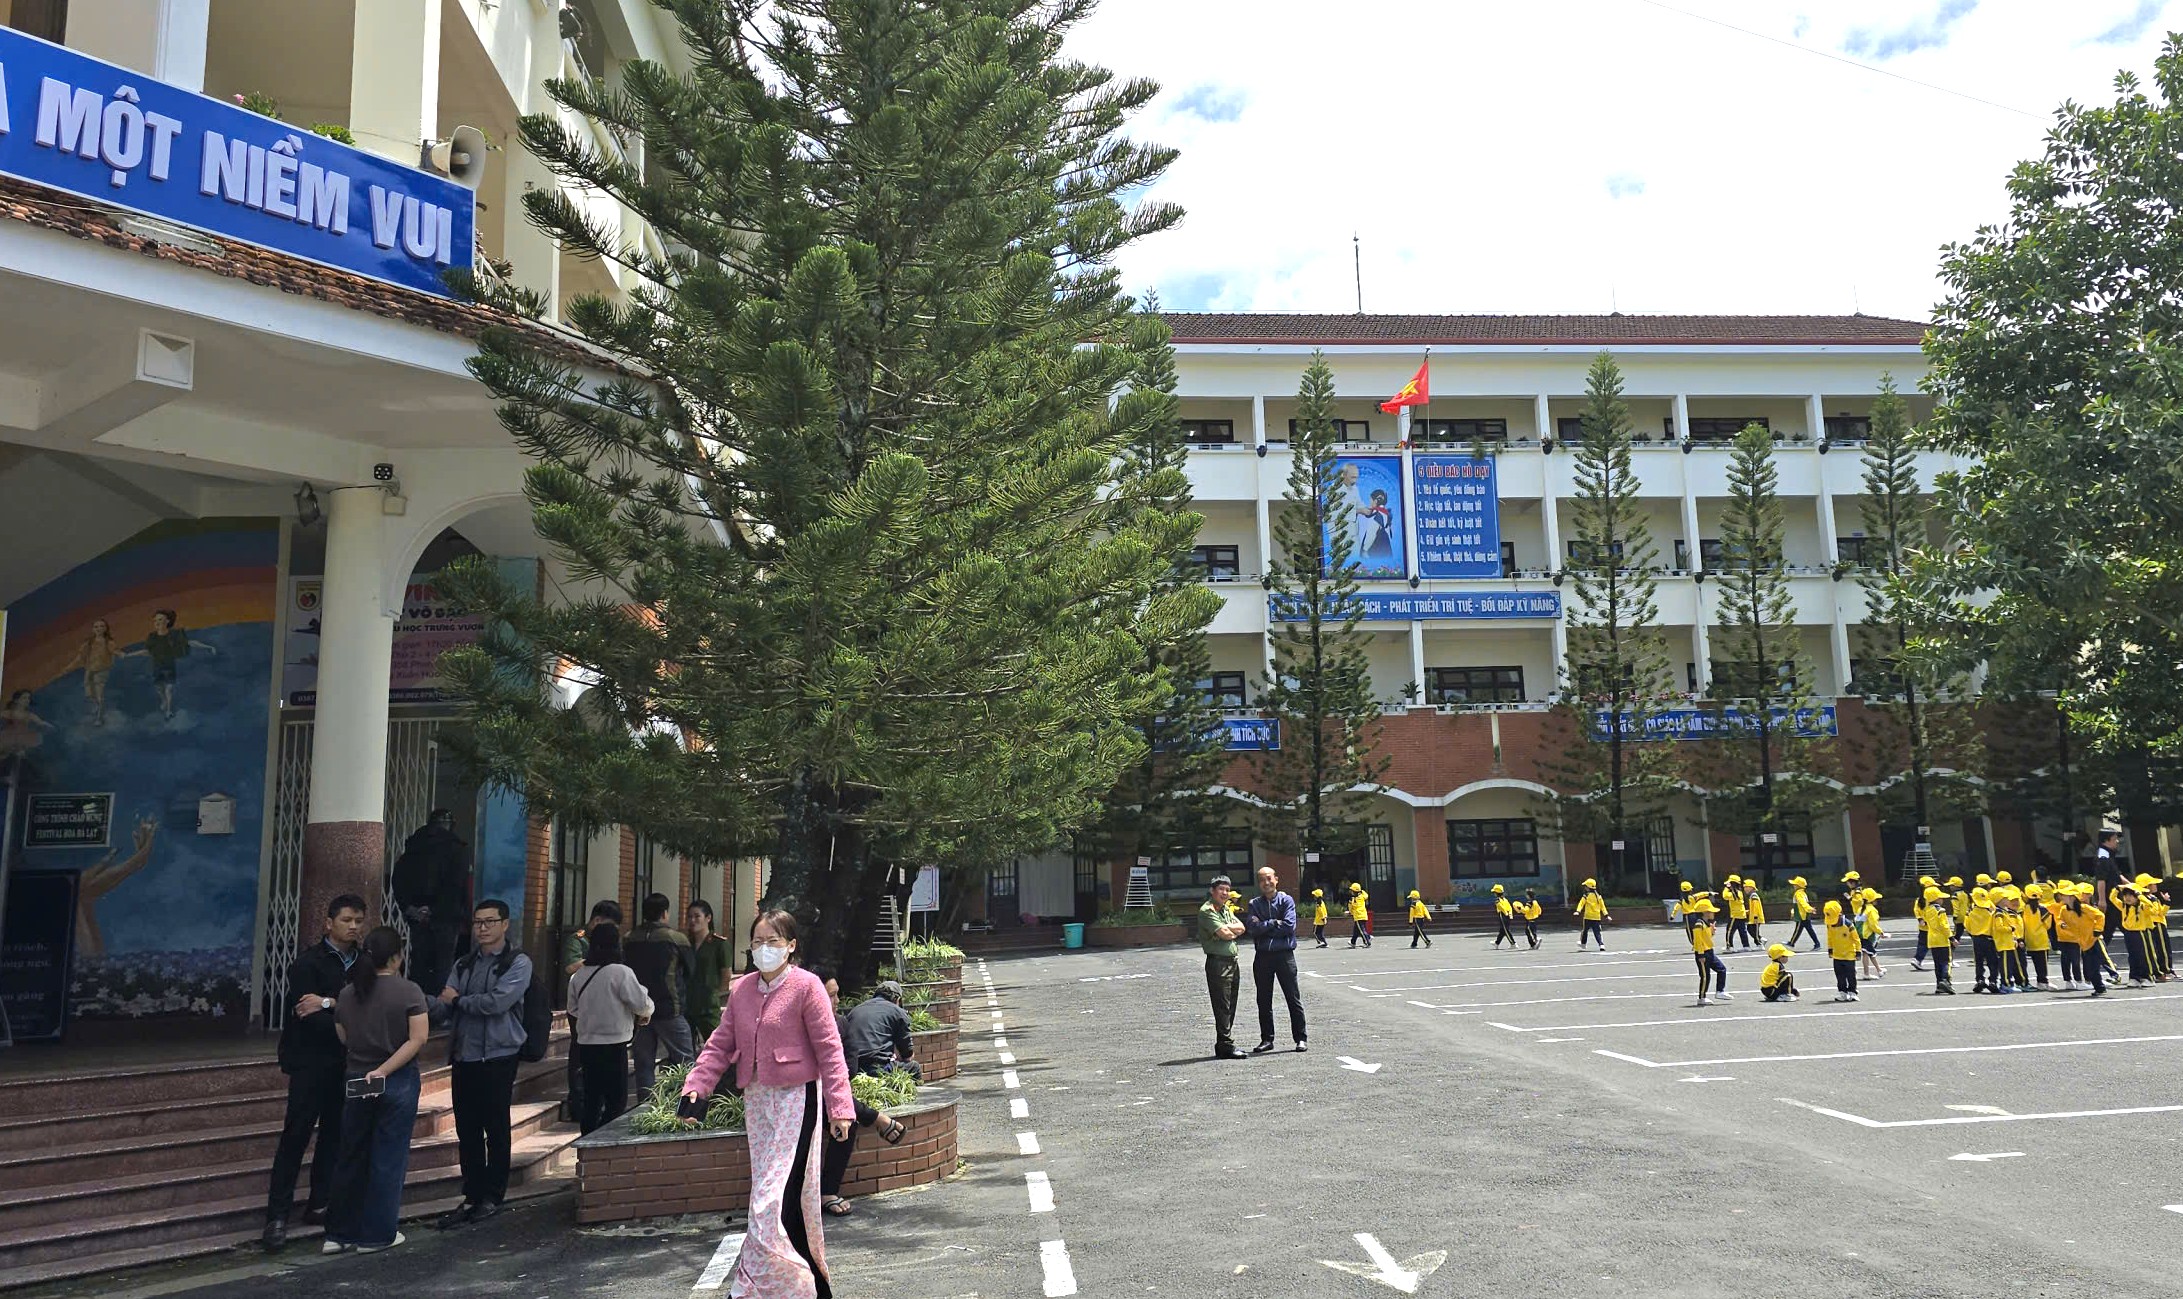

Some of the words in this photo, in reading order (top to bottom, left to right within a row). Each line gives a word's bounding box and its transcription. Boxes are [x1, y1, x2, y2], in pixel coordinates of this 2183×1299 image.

[35, 76, 182, 187] MỘT
[200, 130, 350, 235] NIỀM
[369, 184, 453, 264] VUI
[1418, 466, 1424, 478] 5
[1426, 462, 1443, 478] ĐIỀU
[1445, 464, 1460, 478] BÁC
[1462, 462, 1472, 478] HỒ
[409, 606, 432, 618] VÕ
[1390, 598, 1411, 613] PHÁT
[1414, 596, 1438, 613] TRIỂN
[1457, 597, 1473, 614] TUỆ
[1531, 597, 1554, 611] NĂNG
[1242, 725, 1256, 741] TÍCH
